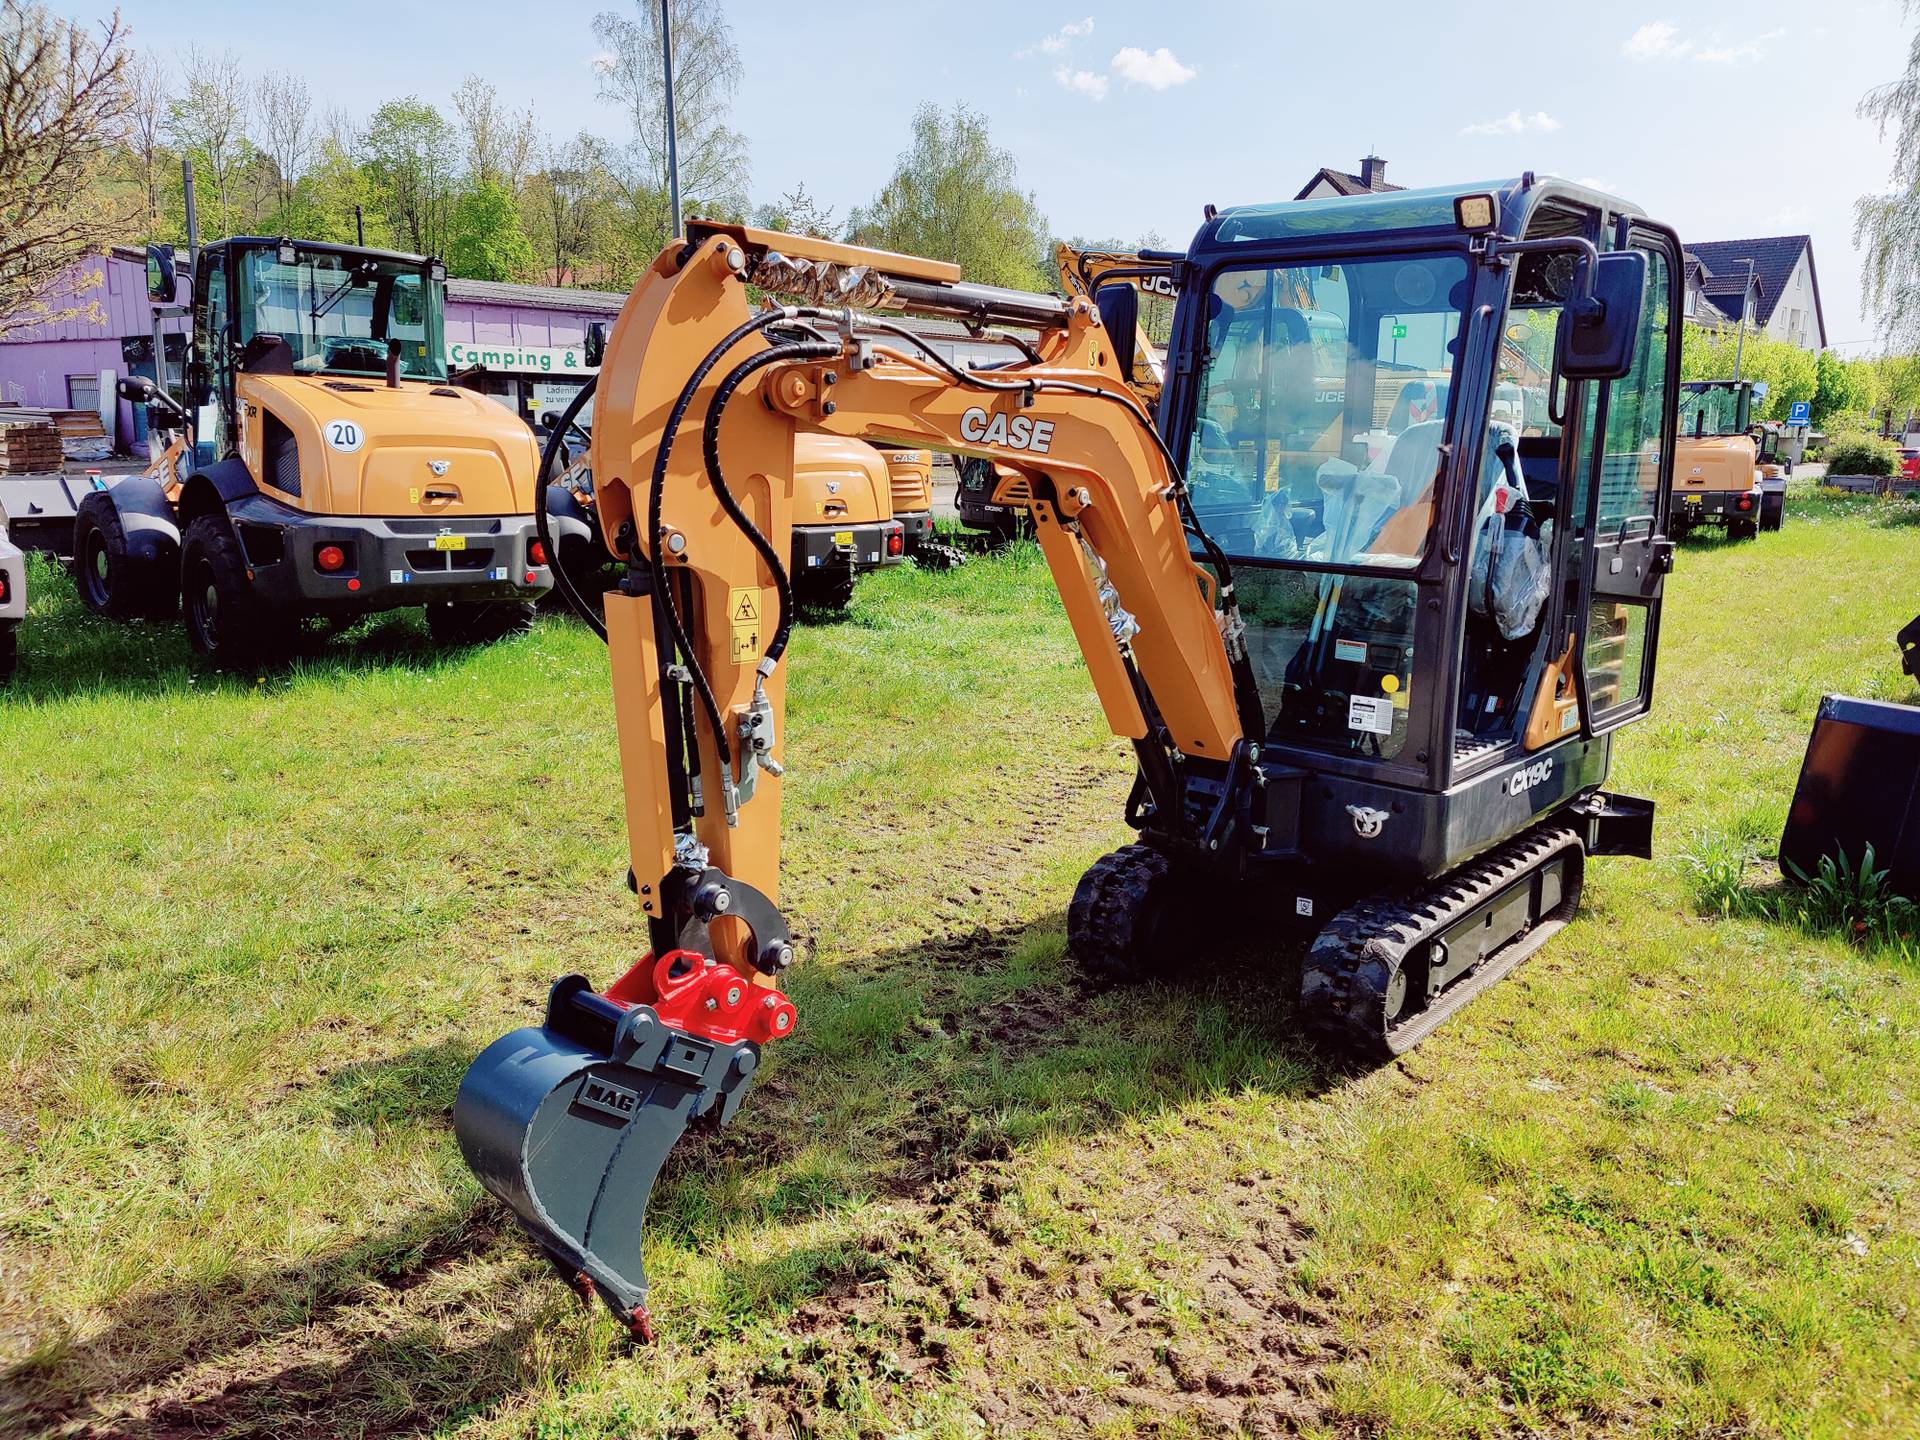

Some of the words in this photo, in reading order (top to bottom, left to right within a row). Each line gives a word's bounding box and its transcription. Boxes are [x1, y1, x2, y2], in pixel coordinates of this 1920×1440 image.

[451, 345, 551, 371] Camping
[564, 351, 577, 368] &
[1795, 404, 1806, 417] P
[332, 424, 356, 445] 20
[960, 406, 1056, 455] CASE
[893, 454, 920, 463] CASE
[1510, 757, 1553, 797] CX19C
[585, 1083, 636, 1113] NAG
